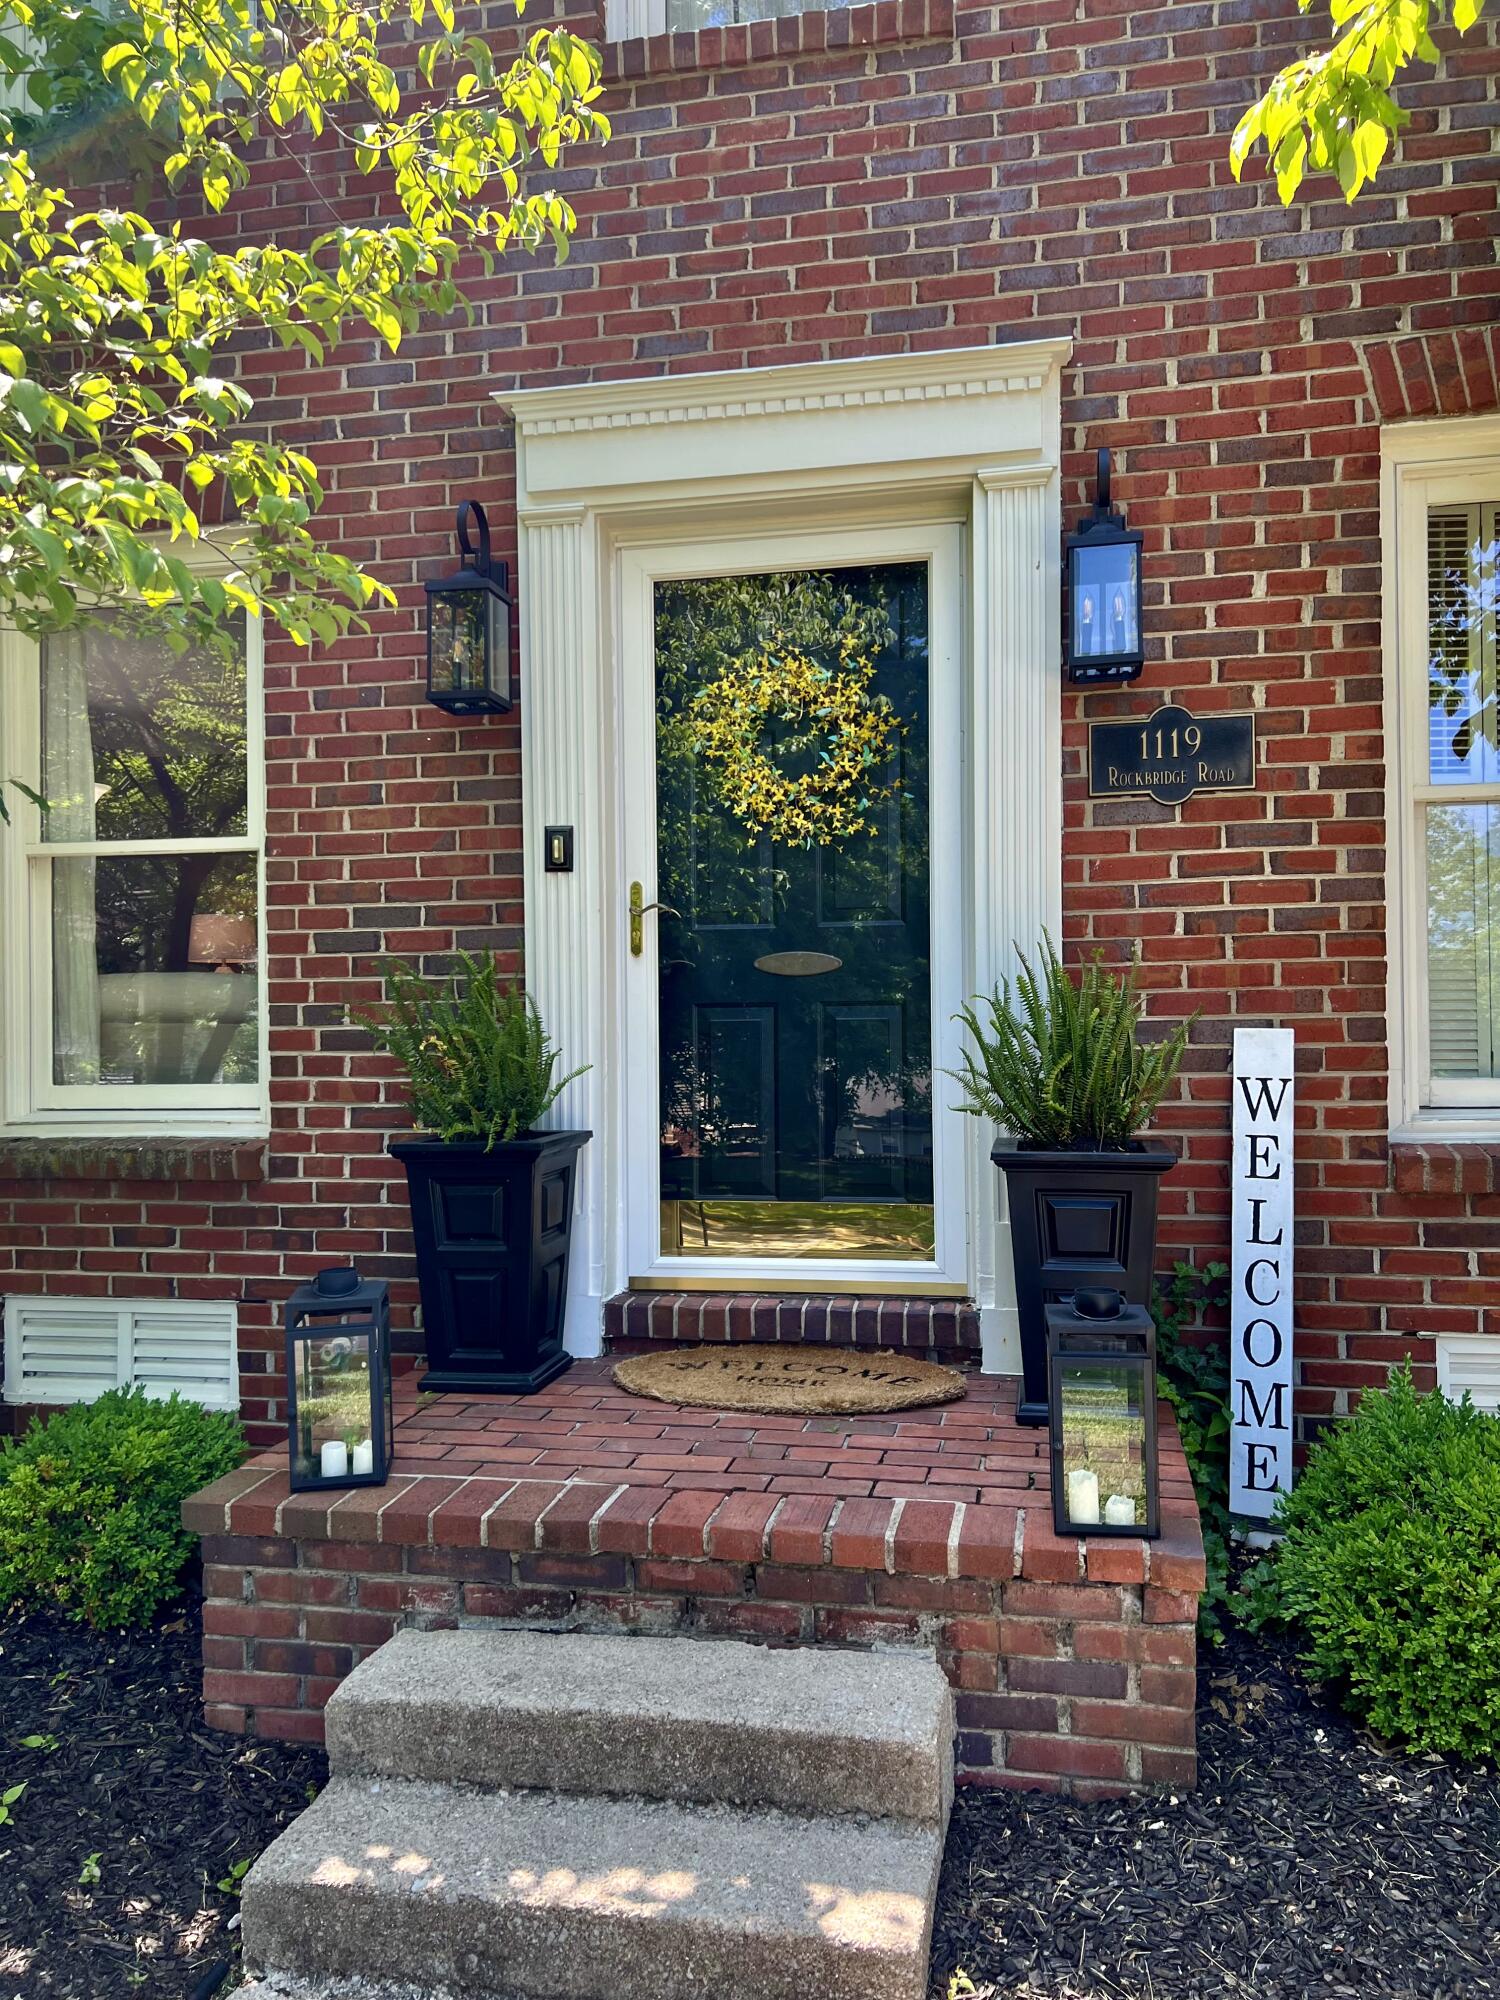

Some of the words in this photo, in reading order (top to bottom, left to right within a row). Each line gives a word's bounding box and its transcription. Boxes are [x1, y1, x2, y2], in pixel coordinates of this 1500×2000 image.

[1140, 726, 1201, 760] 1119
[1234, 1076, 1293, 1493] WELCOME
[665, 1359, 923, 1387] WELCOME
